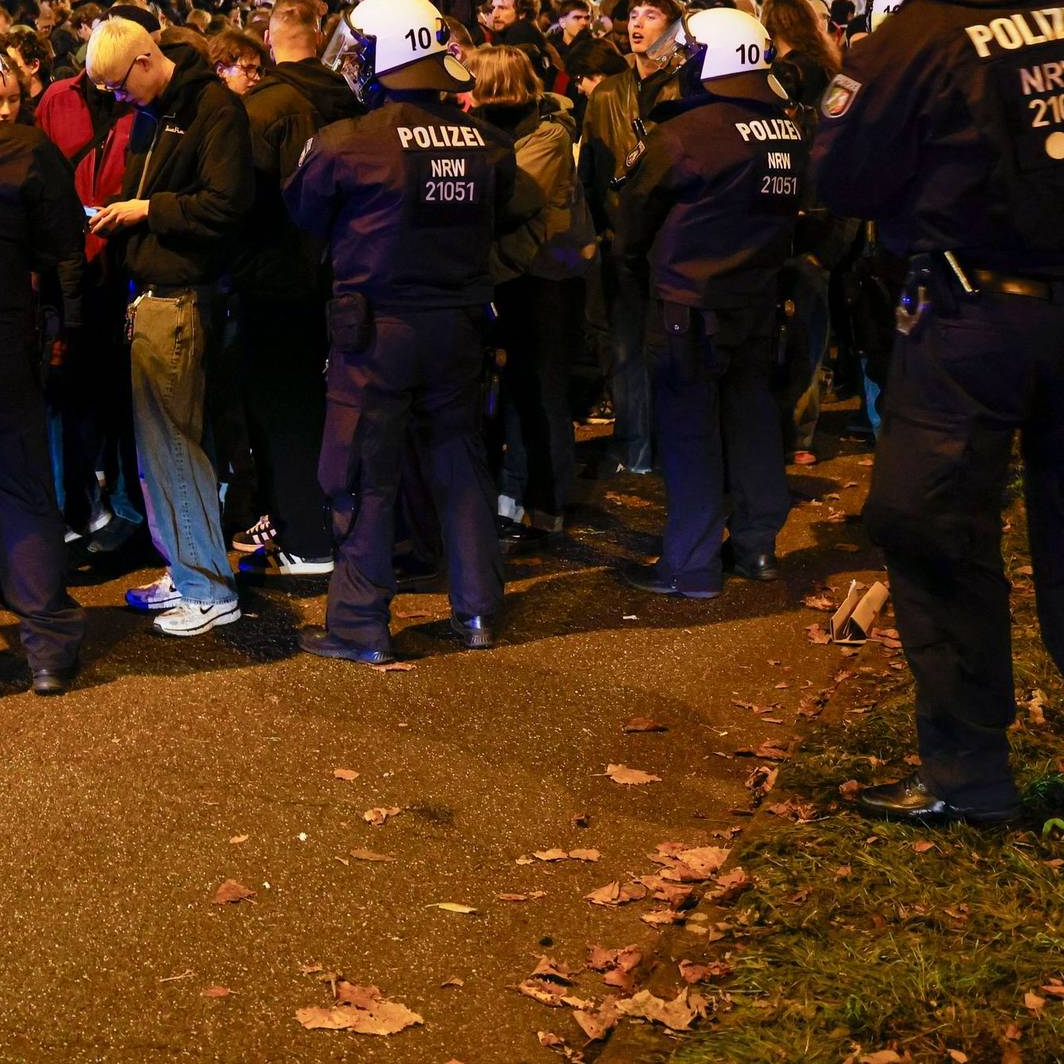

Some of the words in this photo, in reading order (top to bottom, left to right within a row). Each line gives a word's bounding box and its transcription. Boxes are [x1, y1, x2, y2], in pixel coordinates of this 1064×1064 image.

[405, 27, 432, 51] 10
[736, 44, 760, 64] 10
[1019, 60, 1064, 96] NR
[397, 126, 485, 149] POLIZEI
[735, 119, 801, 142] POLIZEI
[431, 159, 465, 178] NRW
[767, 152, 791, 170] NRW
[425, 181, 474, 202] 21051
[760, 175, 797, 195] 21051
